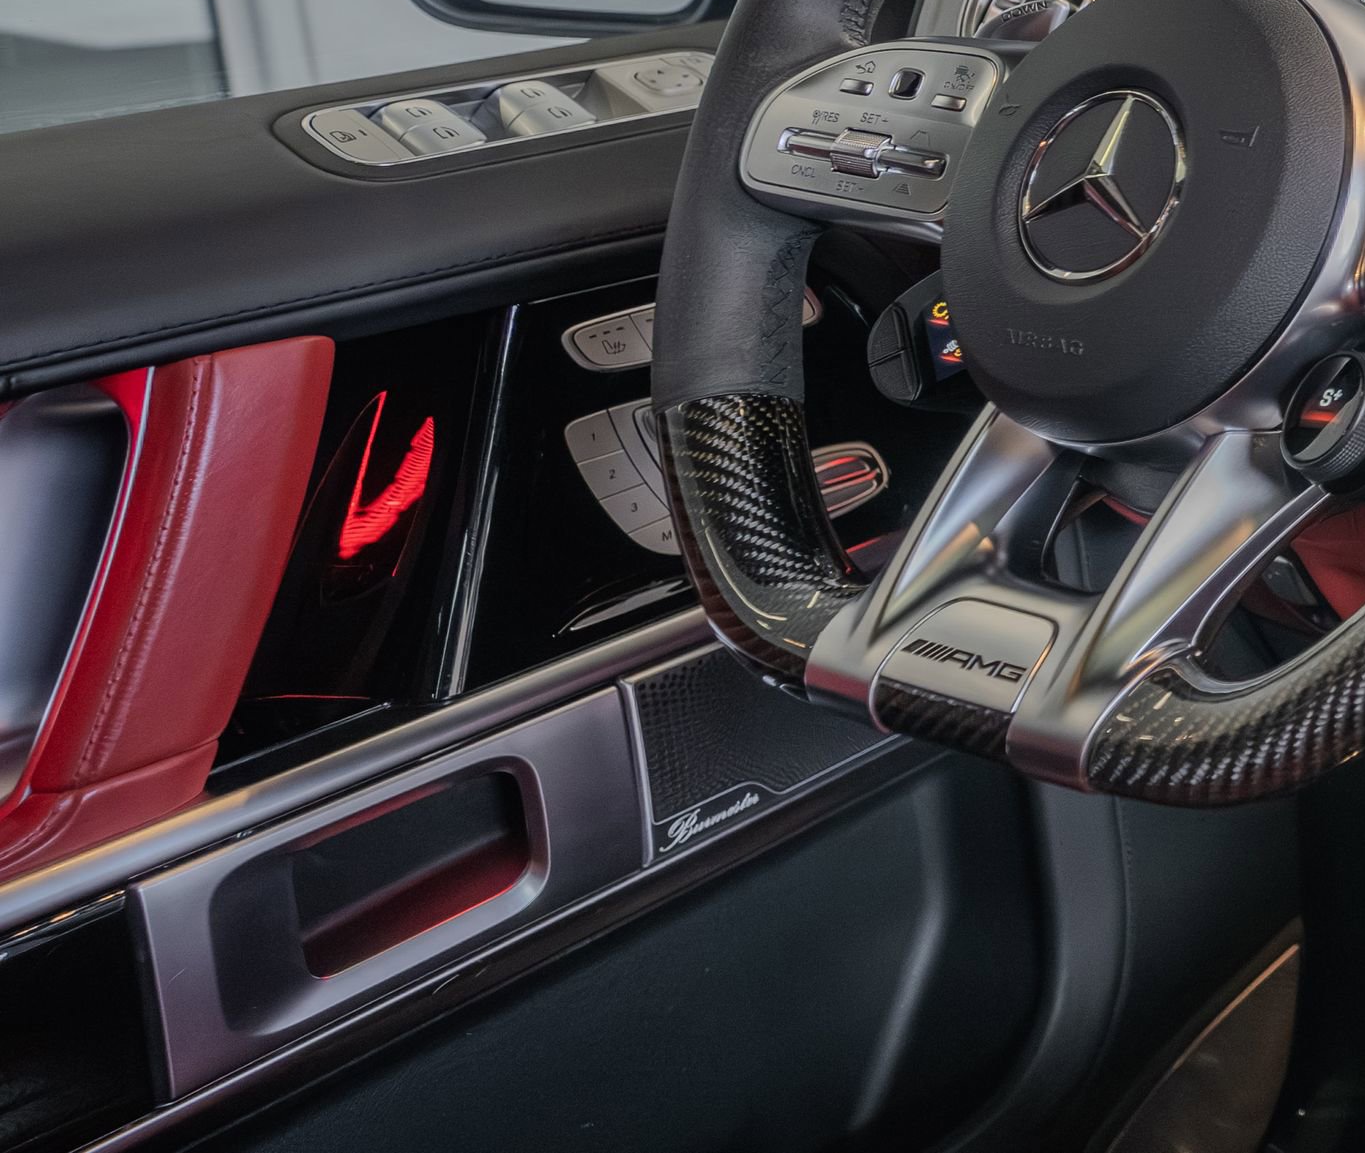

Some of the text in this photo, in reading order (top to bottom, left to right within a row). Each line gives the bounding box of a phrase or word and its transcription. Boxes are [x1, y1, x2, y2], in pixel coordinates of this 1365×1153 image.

[1319, 388, 1344, 407] S+
[608, 468, 617, 480] 2
[630, 502, 639, 513] 3
[661, 530, 673, 542] M
